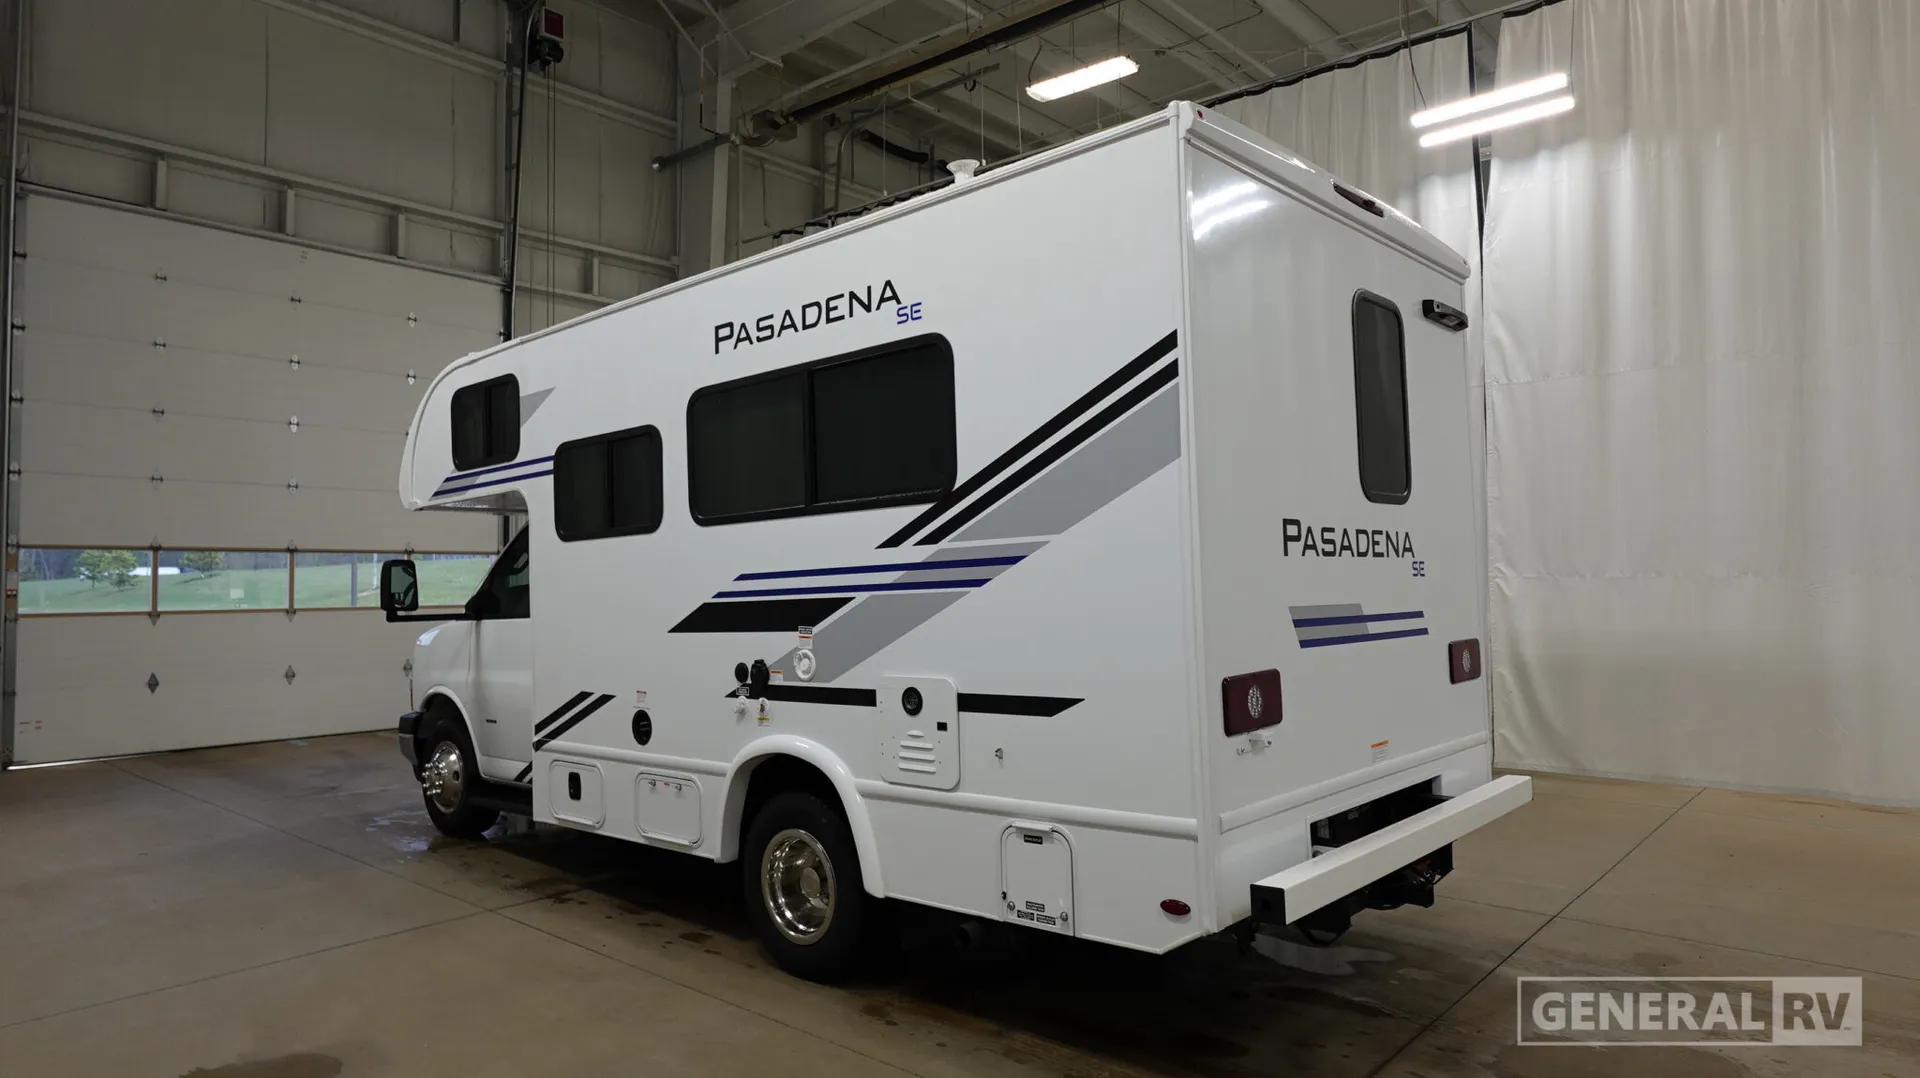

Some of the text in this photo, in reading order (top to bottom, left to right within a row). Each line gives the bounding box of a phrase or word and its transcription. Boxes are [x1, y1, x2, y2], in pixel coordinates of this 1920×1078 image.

[714, 279, 902, 354] PASADENA
[896, 302, 922, 325] SE
[1282, 518, 1415, 558] PASADENA
[1411, 561, 1425, 577] SE
